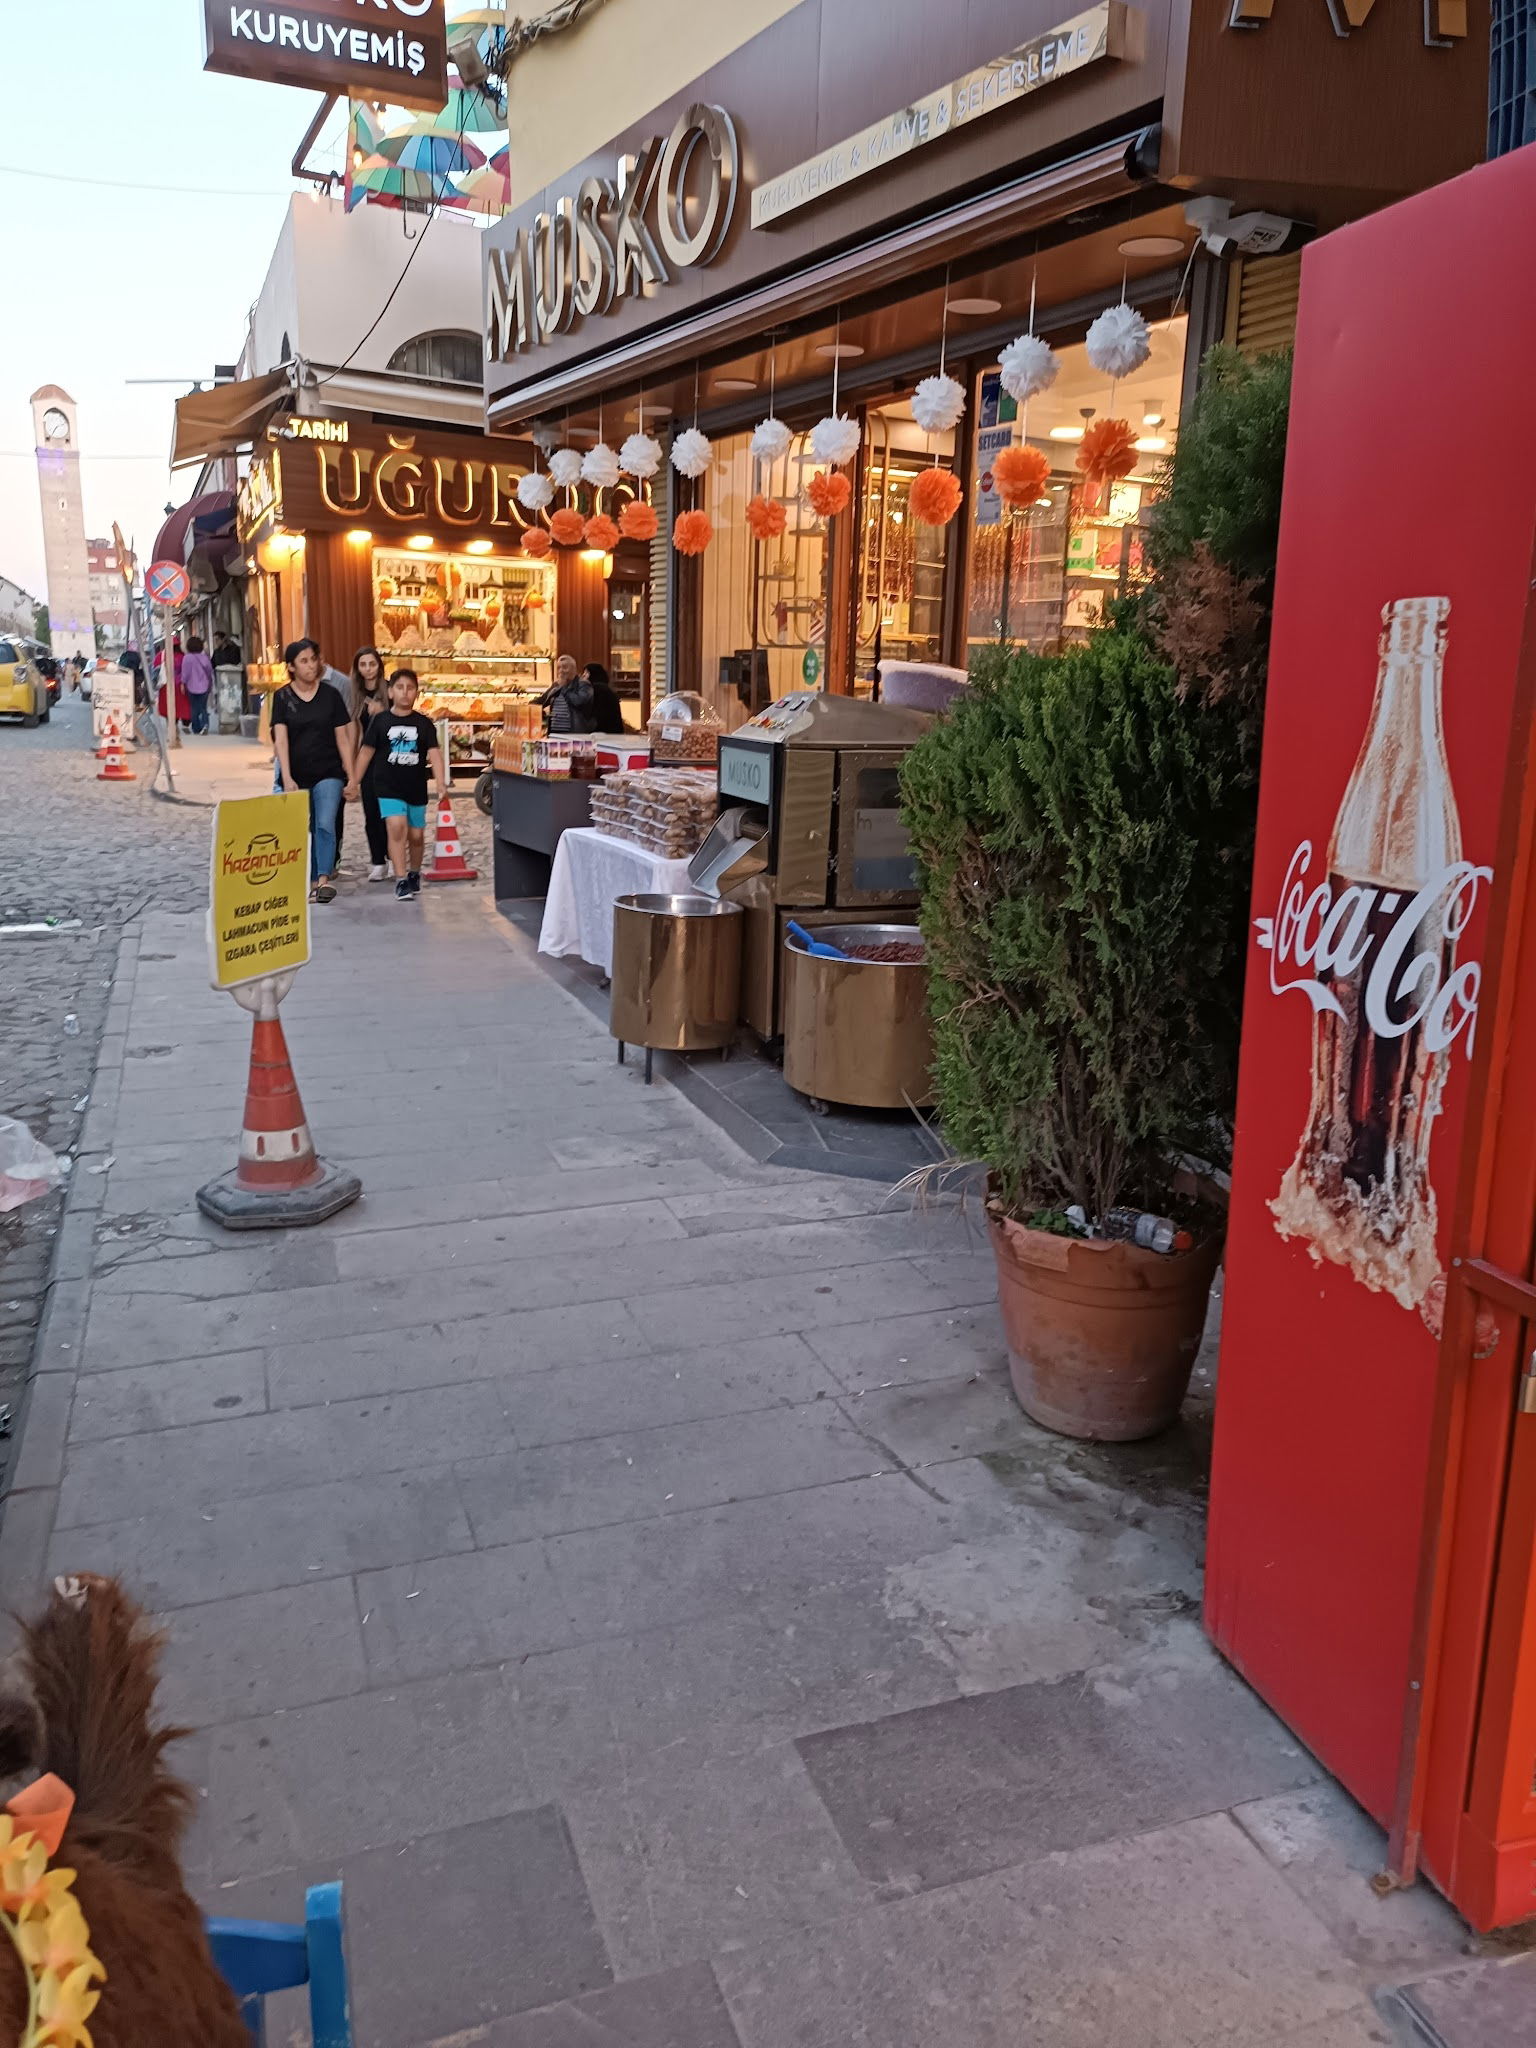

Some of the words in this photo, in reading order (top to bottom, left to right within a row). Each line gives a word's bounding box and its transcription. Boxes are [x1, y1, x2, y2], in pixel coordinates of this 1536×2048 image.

[230, 6, 426, 76] KURUYEMİŞ
[850, 145, 862, 169] &
[867, 109, 931, 163] KAHVE
[935, 100, 948, 125] &
[955, 24, 1091, 120] ŞEKERLEME
[289, 418, 350, 443] TARİHİ
[233, 903, 261, 919] KEBAP
[222, 920, 270, 942] LAHMACUN
